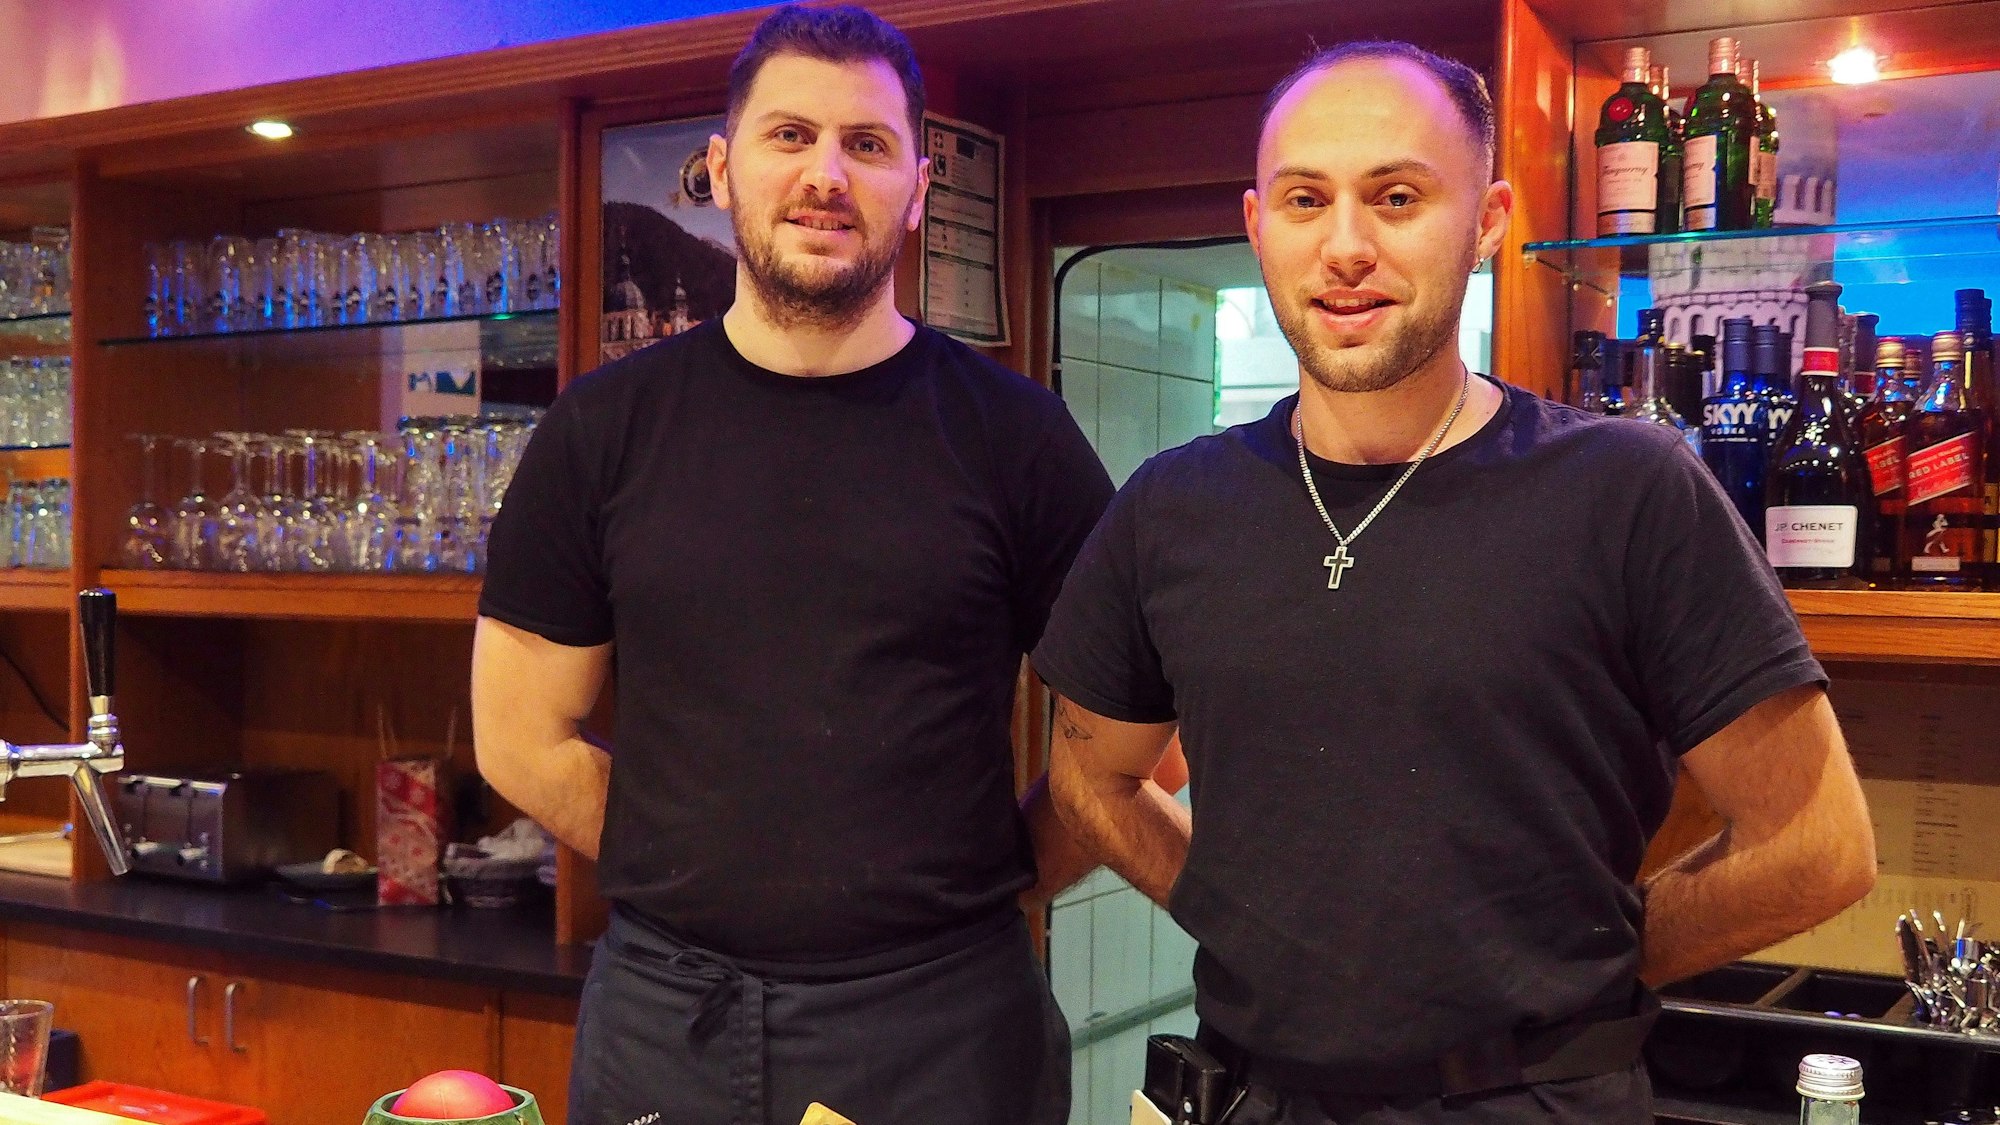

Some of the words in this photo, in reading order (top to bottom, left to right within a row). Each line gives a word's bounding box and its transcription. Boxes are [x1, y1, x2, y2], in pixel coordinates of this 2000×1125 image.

[1703, 403, 1758, 426] SKYY
[1908, 466, 1931, 480] RED
[1933, 453, 1970, 471] LABEL
[1791, 522, 1844, 531] CHENET
